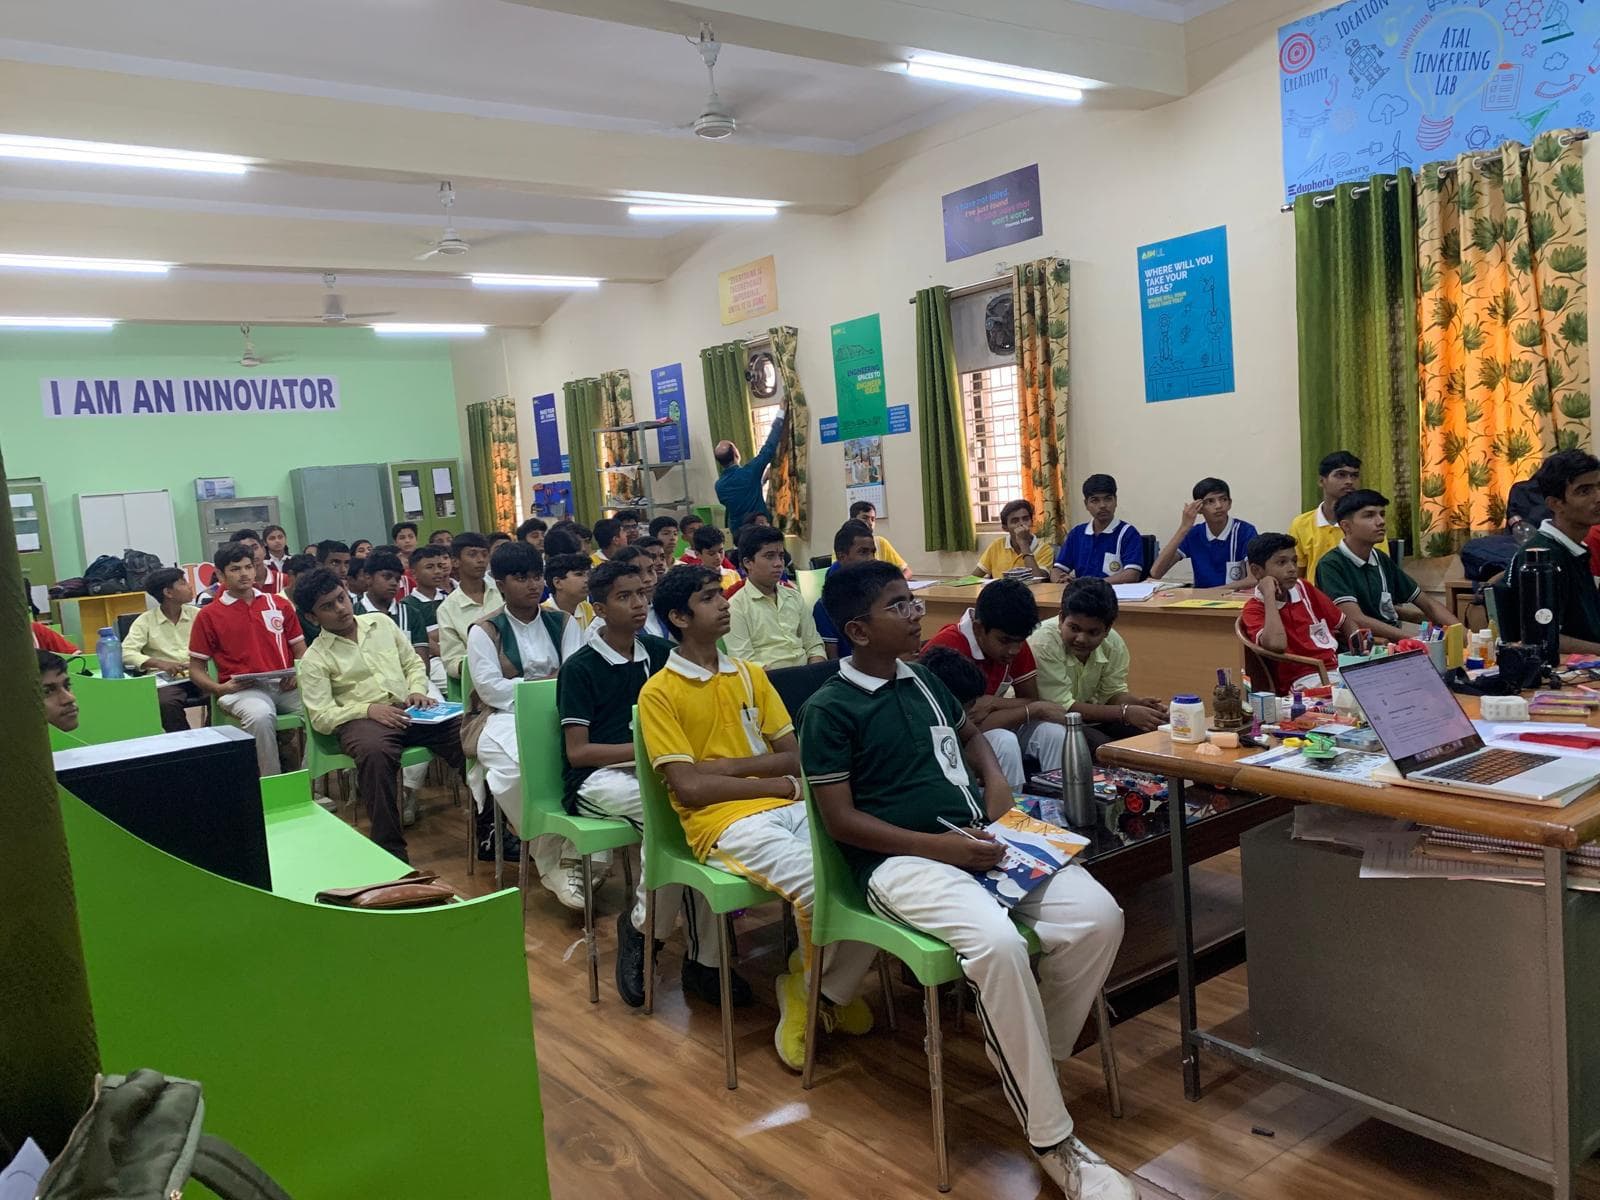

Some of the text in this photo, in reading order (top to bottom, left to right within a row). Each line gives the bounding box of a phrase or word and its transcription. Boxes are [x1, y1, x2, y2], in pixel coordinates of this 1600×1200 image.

[1397, 11, 1433, 60] INNOVATION
[1440, 27, 1471, 49] ATAL
[1413, 50, 1490, 73] TINKERING
[1283, 66, 1329, 94] CREATIVITY
[1435, 74, 1458, 96] LAB
[1288, 177, 1334, 196] Eduphoria
[1144, 254, 1214, 278] WHERE WILL YOU
[1145, 270, 1188, 288] TAKE YOUR
[1147, 283, 1173, 296] IDEAS?
[50, 378, 336, 415] I AM AN INNOVATOR
